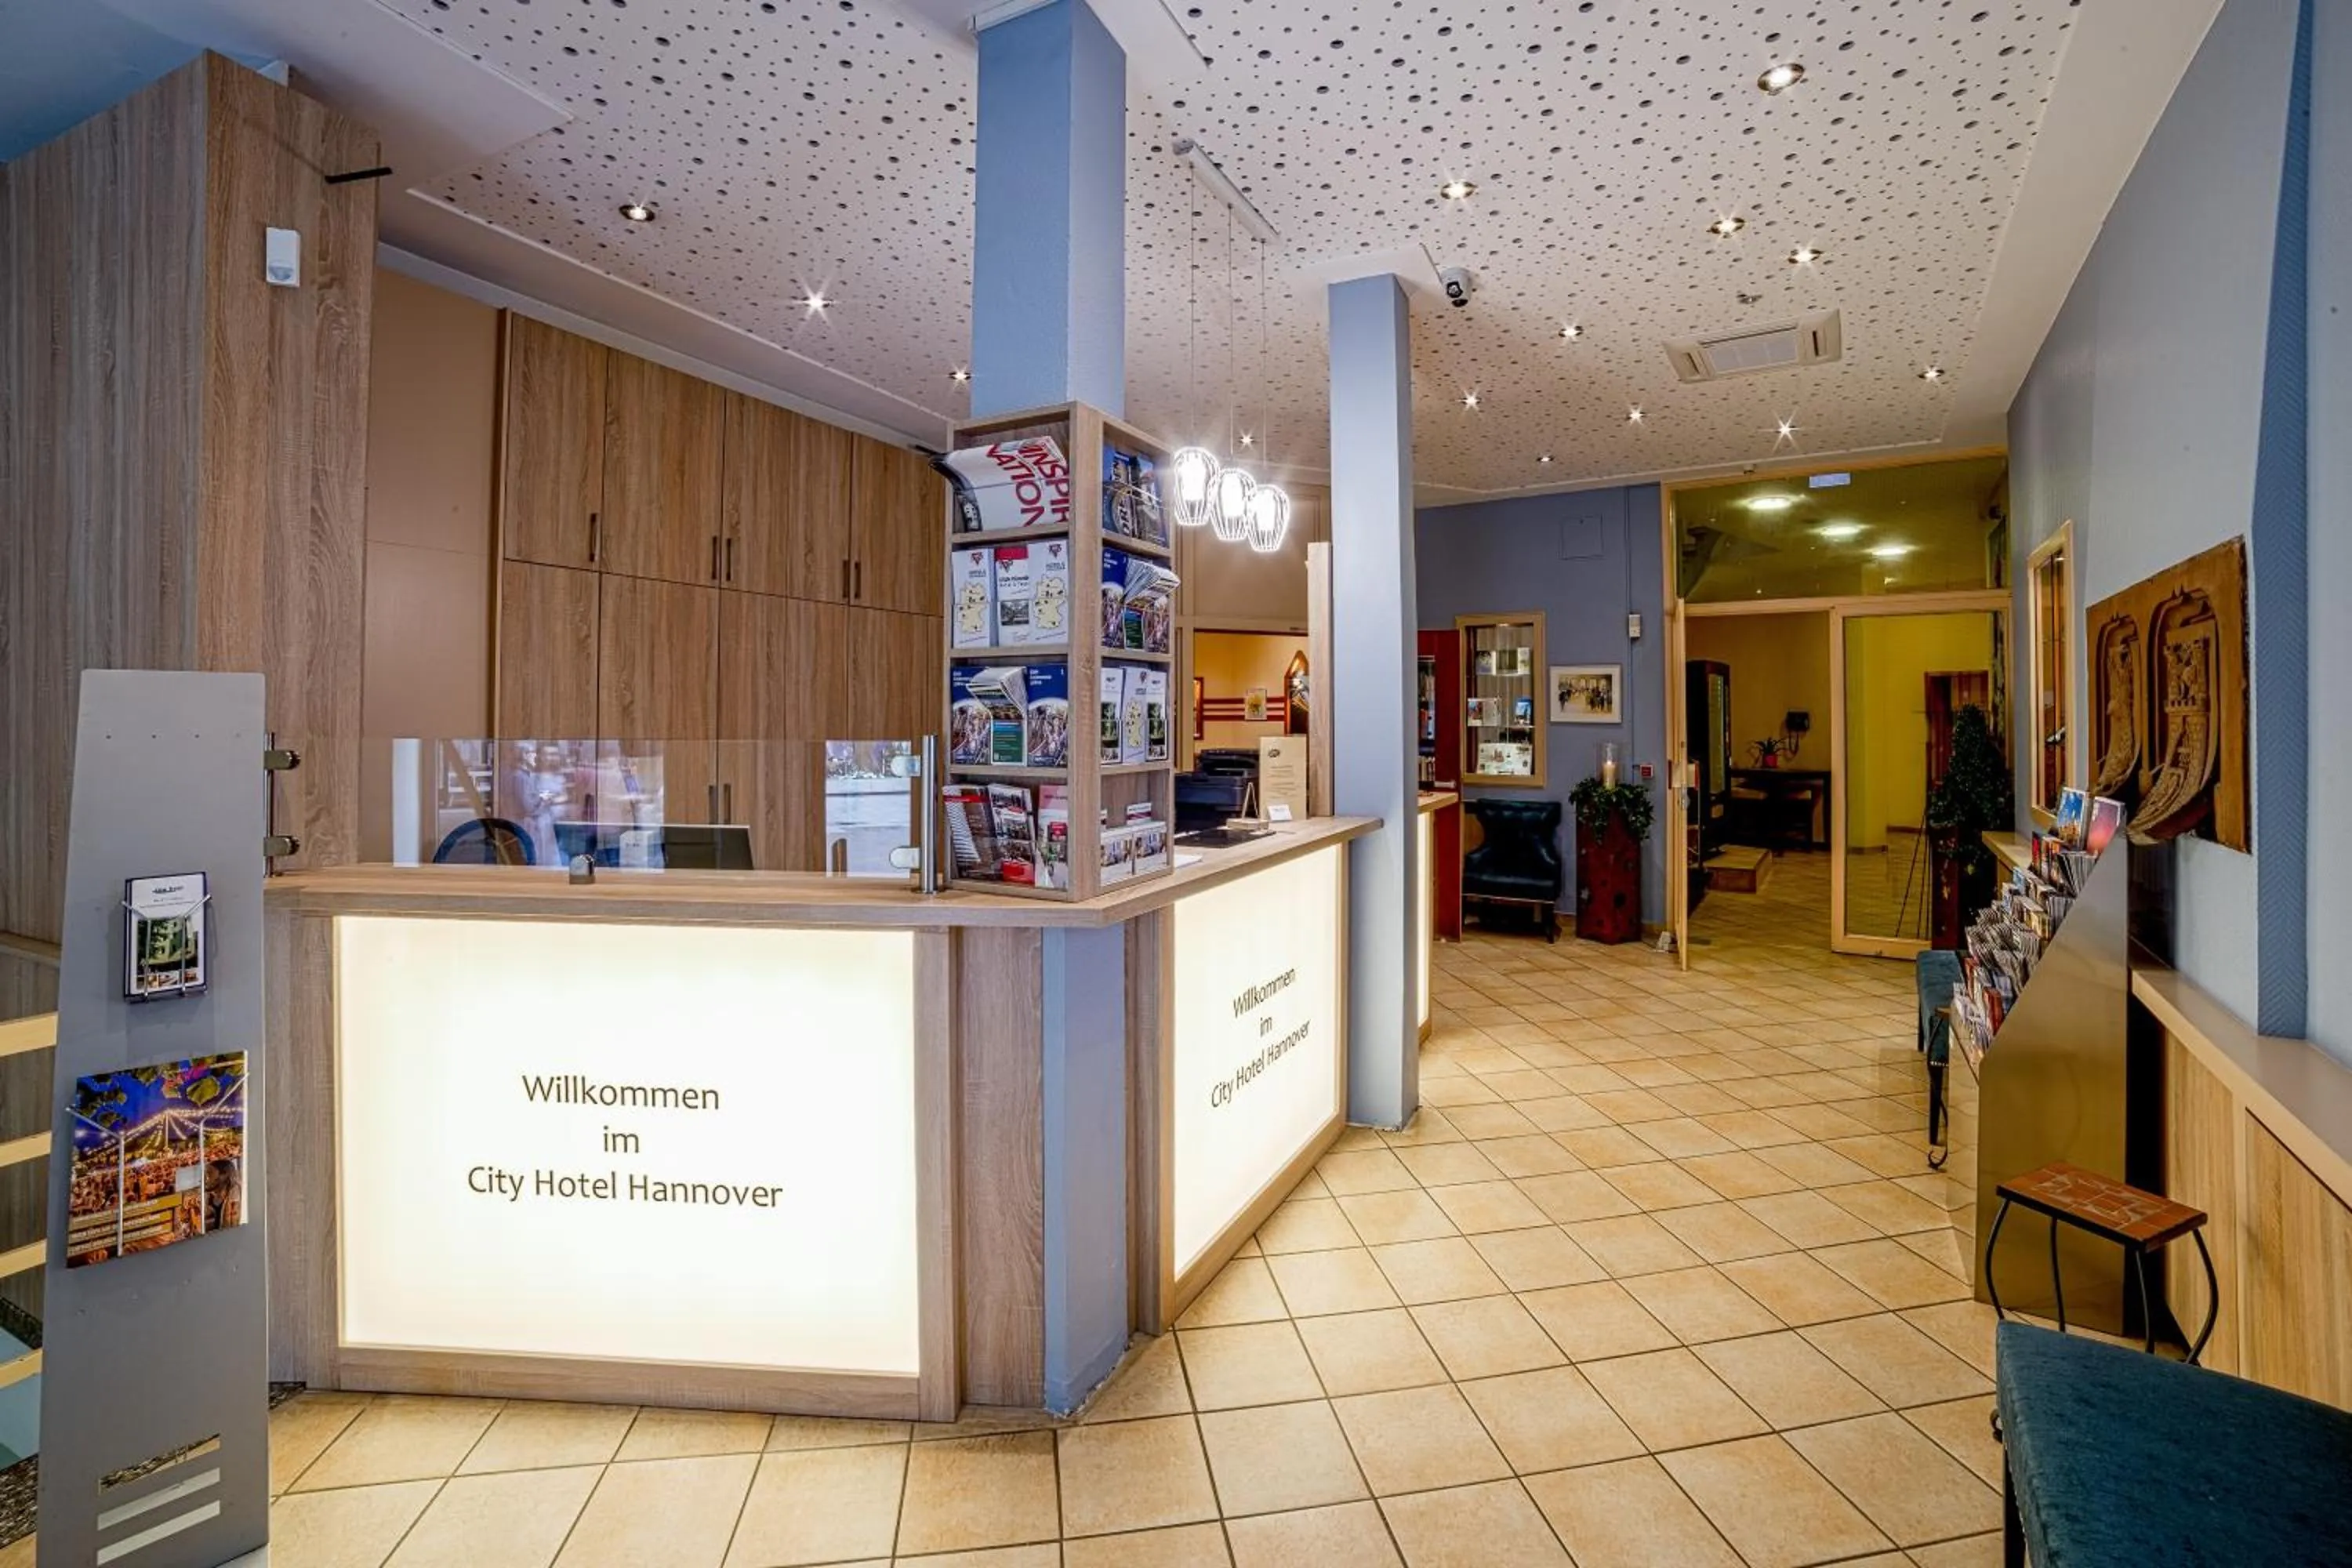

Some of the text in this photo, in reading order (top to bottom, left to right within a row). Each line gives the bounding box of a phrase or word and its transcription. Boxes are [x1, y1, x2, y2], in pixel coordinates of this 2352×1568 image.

[1233, 968, 1296, 1018] Willkommen
[1260, 1017, 1272, 1037] im
[1211, 1019, 1311, 1108] City Hotel Hannover
[522, 1075, 719, 1110] Willkommen
[603, 1125, 640, 1154] im
[467, 1166, 783, 1208] City Hotel Hannover
